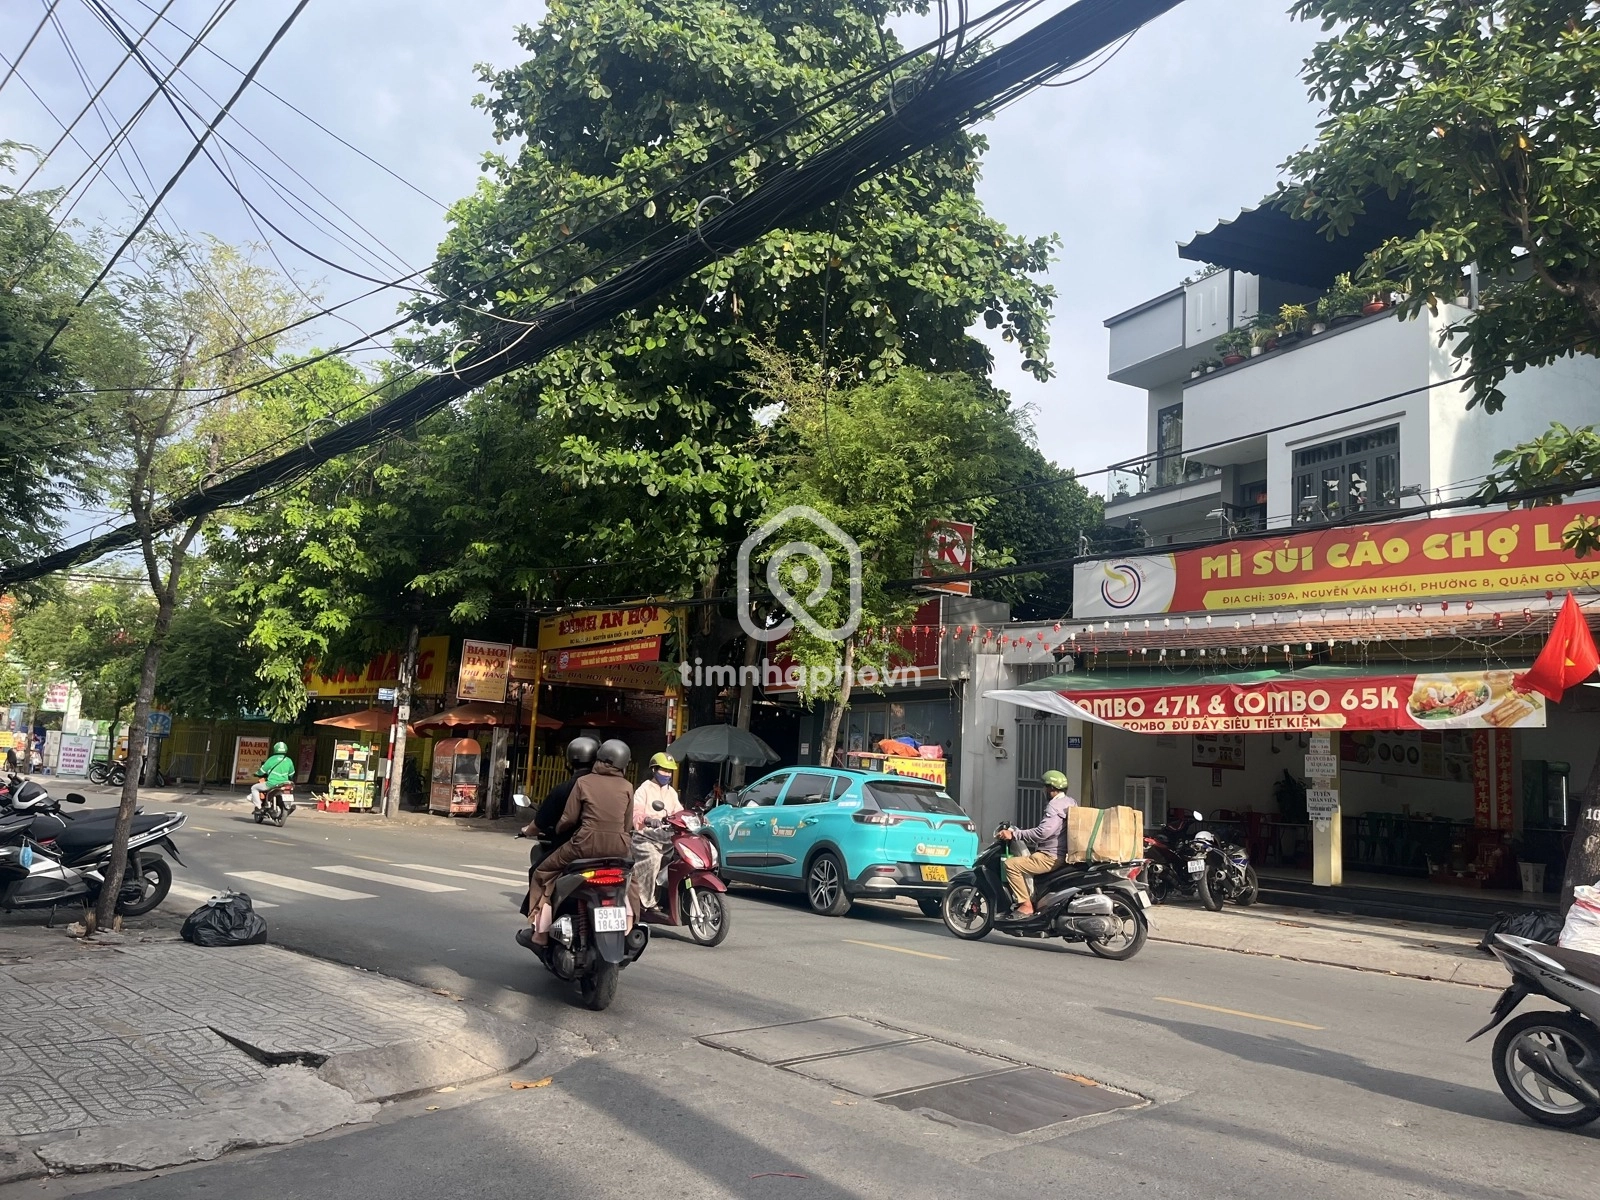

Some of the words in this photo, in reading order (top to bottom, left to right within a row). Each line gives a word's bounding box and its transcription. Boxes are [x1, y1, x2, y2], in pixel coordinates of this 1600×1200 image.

[1201, 549, 1242, 580] MÌ
[1253, 539, 1313, 576] SỦI
[1326, 531, 1410, 569] CẢO
[1422, 523, 1519, 563] CHỢ
[1222, 595, 1241, 606] ĐỊA
[1244, 591, 1265, 603] CHỈ:
[1268, 591, 1298, 602] 309A,
[1302, 585, 1349, 599] NGUYỄN
[1353, 584, 1378, 596] VĂN
[1381, 579, 1416, 594] KHỐI,
[1420, 577, 1478, 591] PHƯỜNG
[1482, 578, 1494, 588] 8,
[1498, 572, 1540, 588] QUẬN
[1544, 570, 1566, 583] GÒ
[1569, 567, 1599, 581] VẤP
[600, 611, 625, 629] AN
[467, 645, 486, 655] BIA
[467, 656, 484, 666] HÀ
[485, 657, 505, 670] NỘI
[1070, 697, 1145, 718] OMBO
[1153, 694, 1200, 716] 47K
[1207, 695, 1226, 715] &
[1234, 689, 1331, 714] COMBO
[1340, 686, 1399, 710] 65K
[1122, 721, 1166, 731] COMBO
[1172, 716, 1189, 730] ĐỦ
[1223, 716, 1250, 729] SIÊU
[1254, 712, 1283, 729] TIẾT
[1286, 714, 1321, 732] KIỆM
[1539, 970, 1585, 992] VISION
